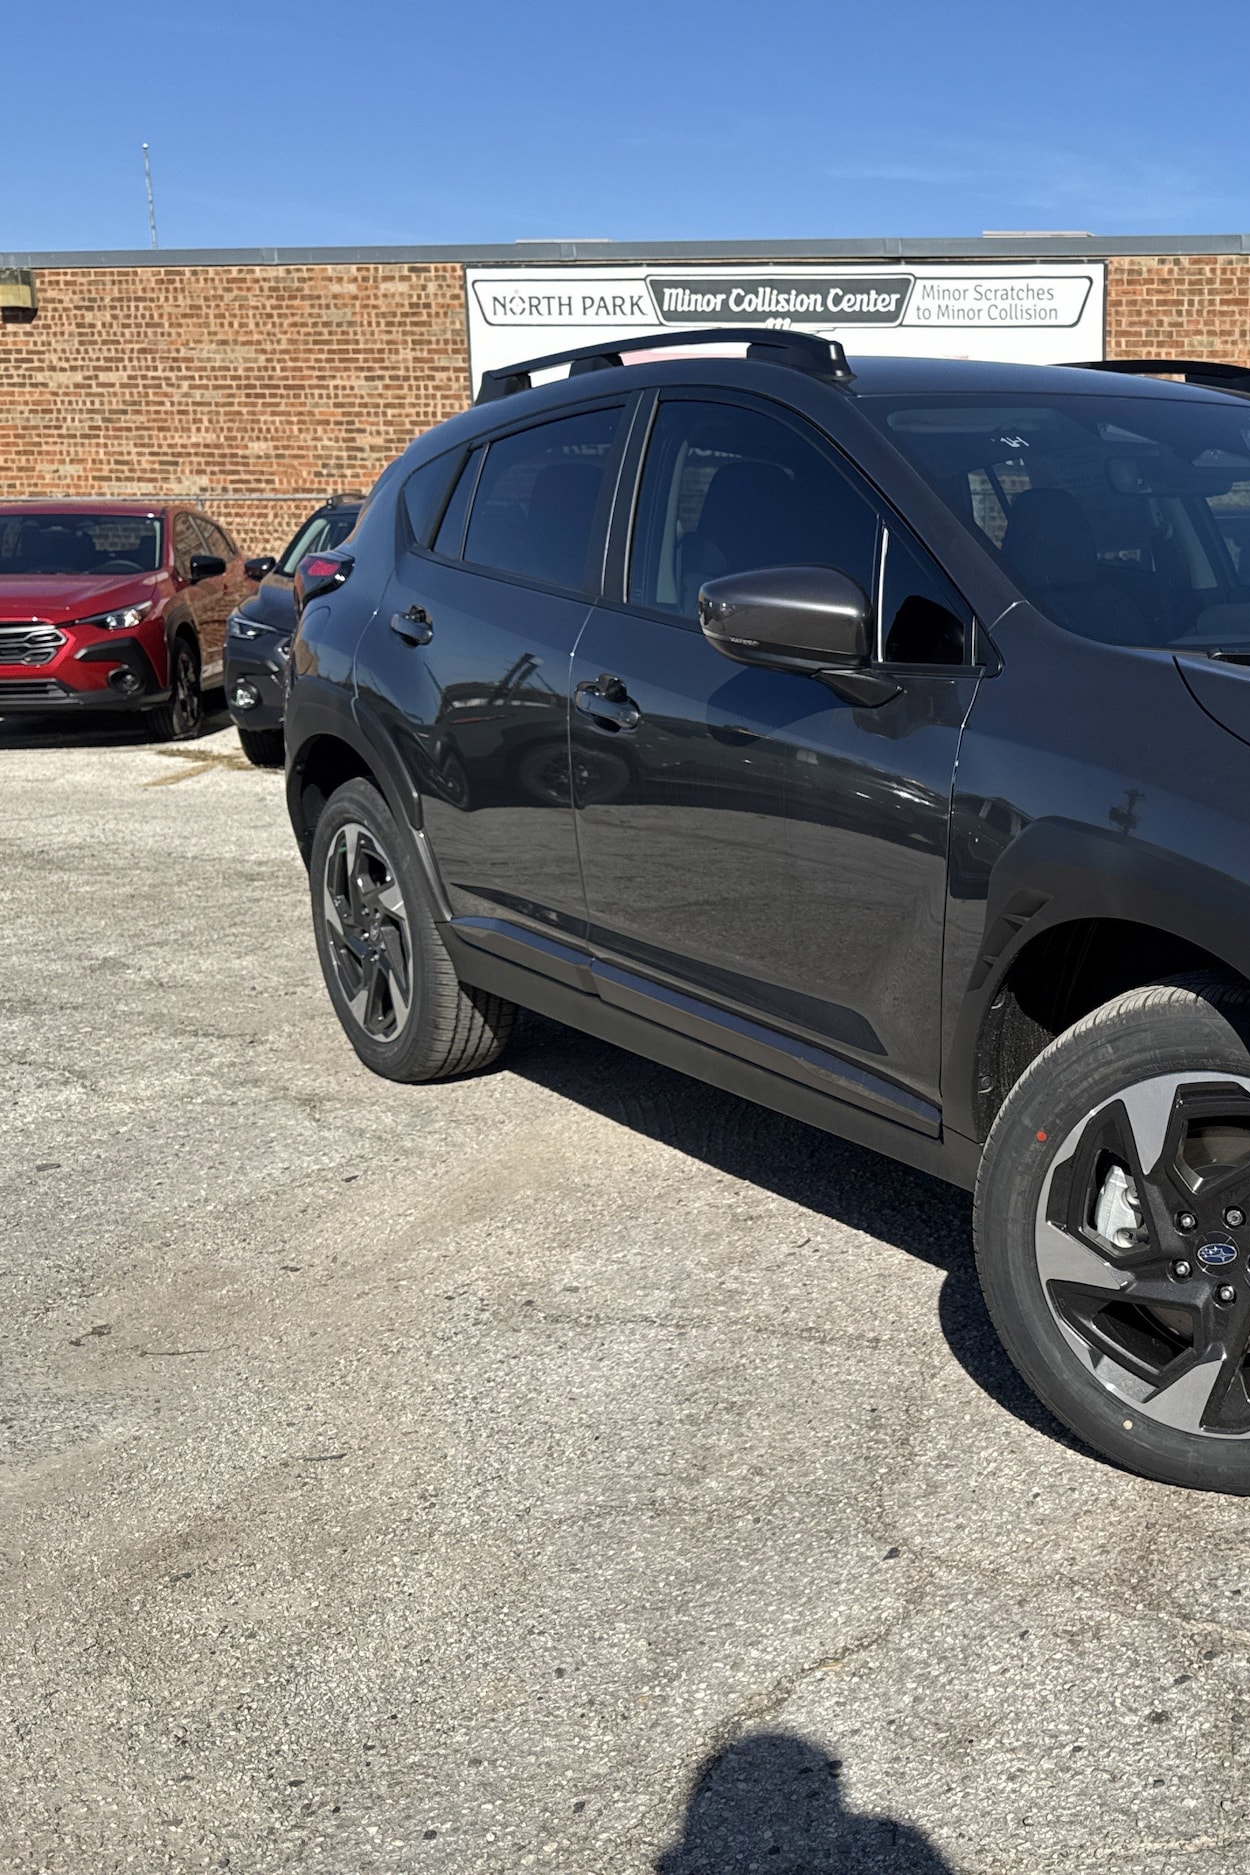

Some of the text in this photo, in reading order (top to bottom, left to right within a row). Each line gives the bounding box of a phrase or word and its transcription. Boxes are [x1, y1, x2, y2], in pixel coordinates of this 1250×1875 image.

[663, 287, 901, 313] Minor Collision Center
[922, 284, 1054, 301] Minor Scratches
[492, 295, 648, 316] NORTH PARK
[916, 303, 1058, 320] to Minor Collision
